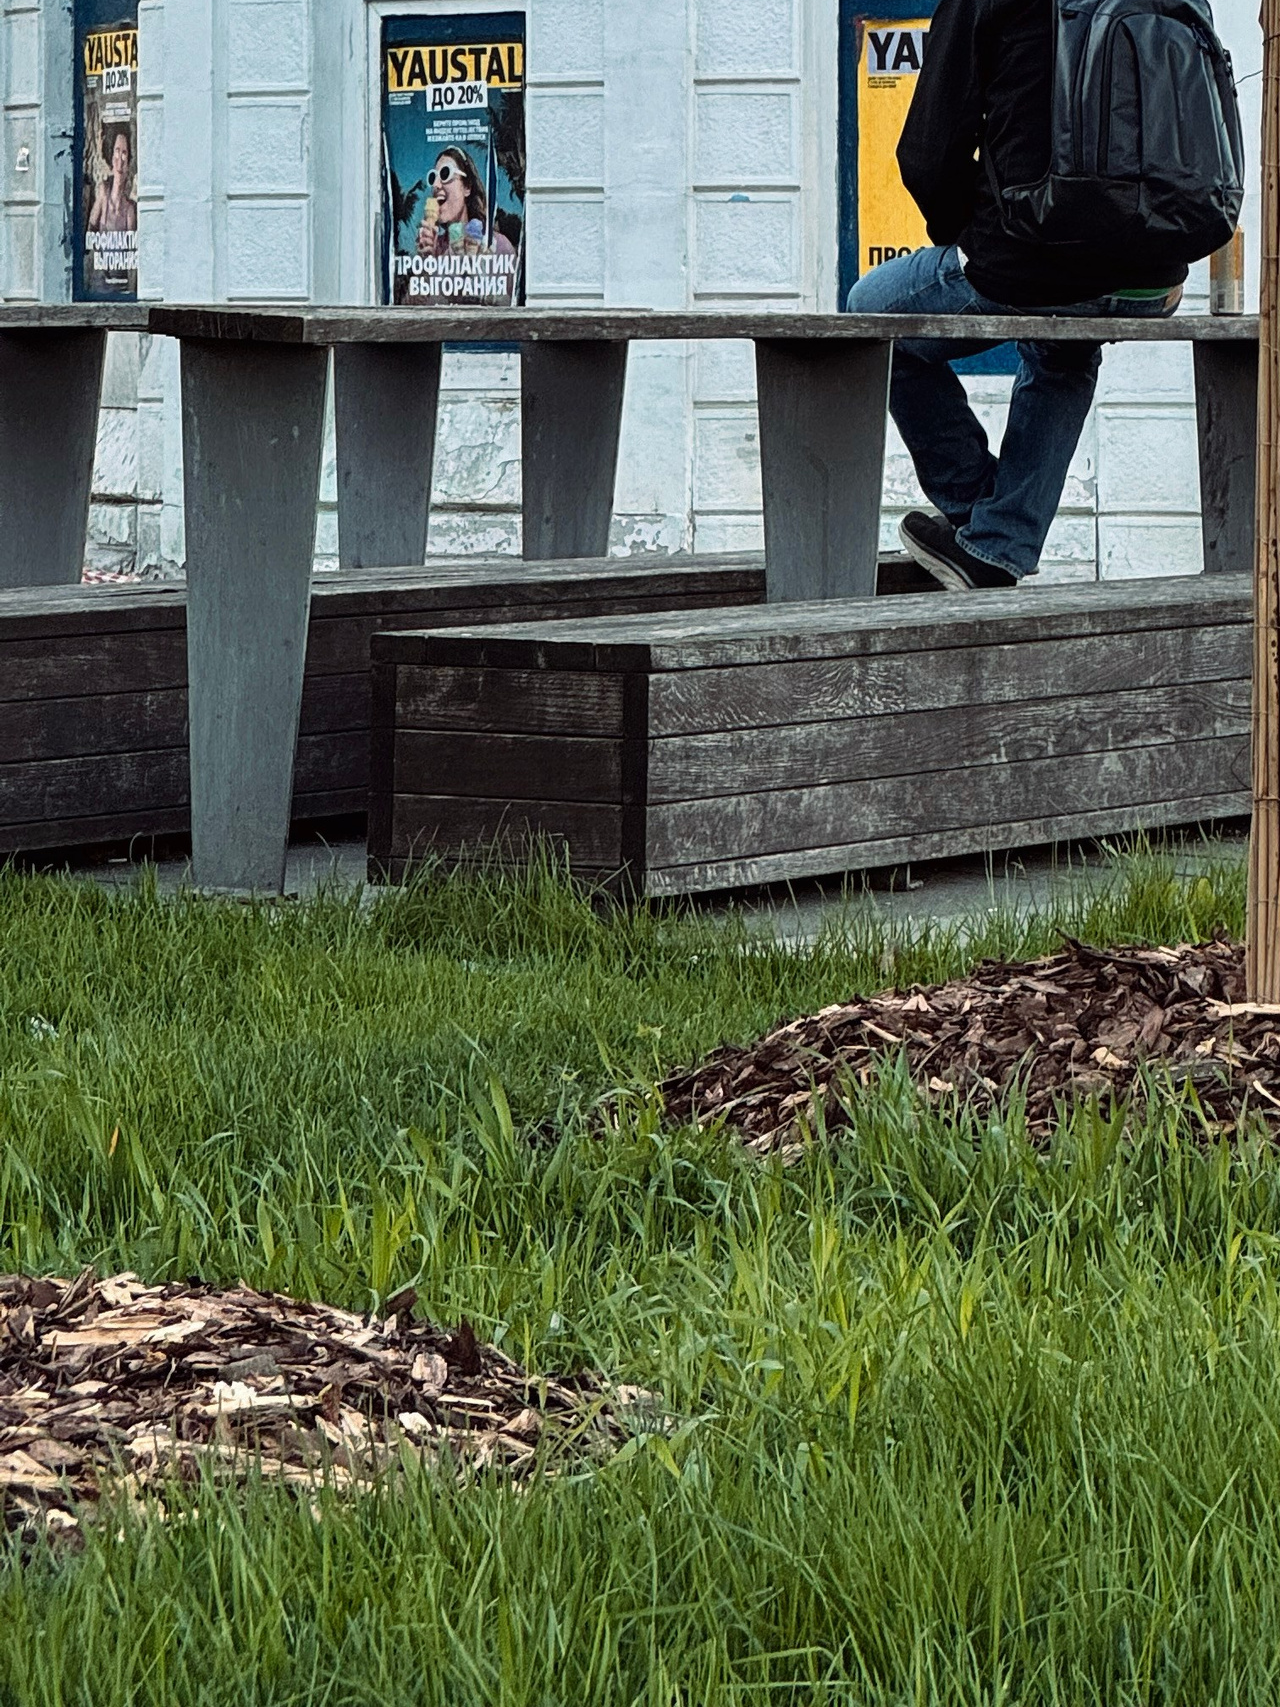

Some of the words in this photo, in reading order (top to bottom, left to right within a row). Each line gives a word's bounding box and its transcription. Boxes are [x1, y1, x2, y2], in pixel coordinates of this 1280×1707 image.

[389, 46, 522, 87] YAUSTAL
[431, 87, 454, 110] ДО
[457, 84, 483, 105] 20%
[409, 276, 507, 296] ВЫГОРАНИЯ
